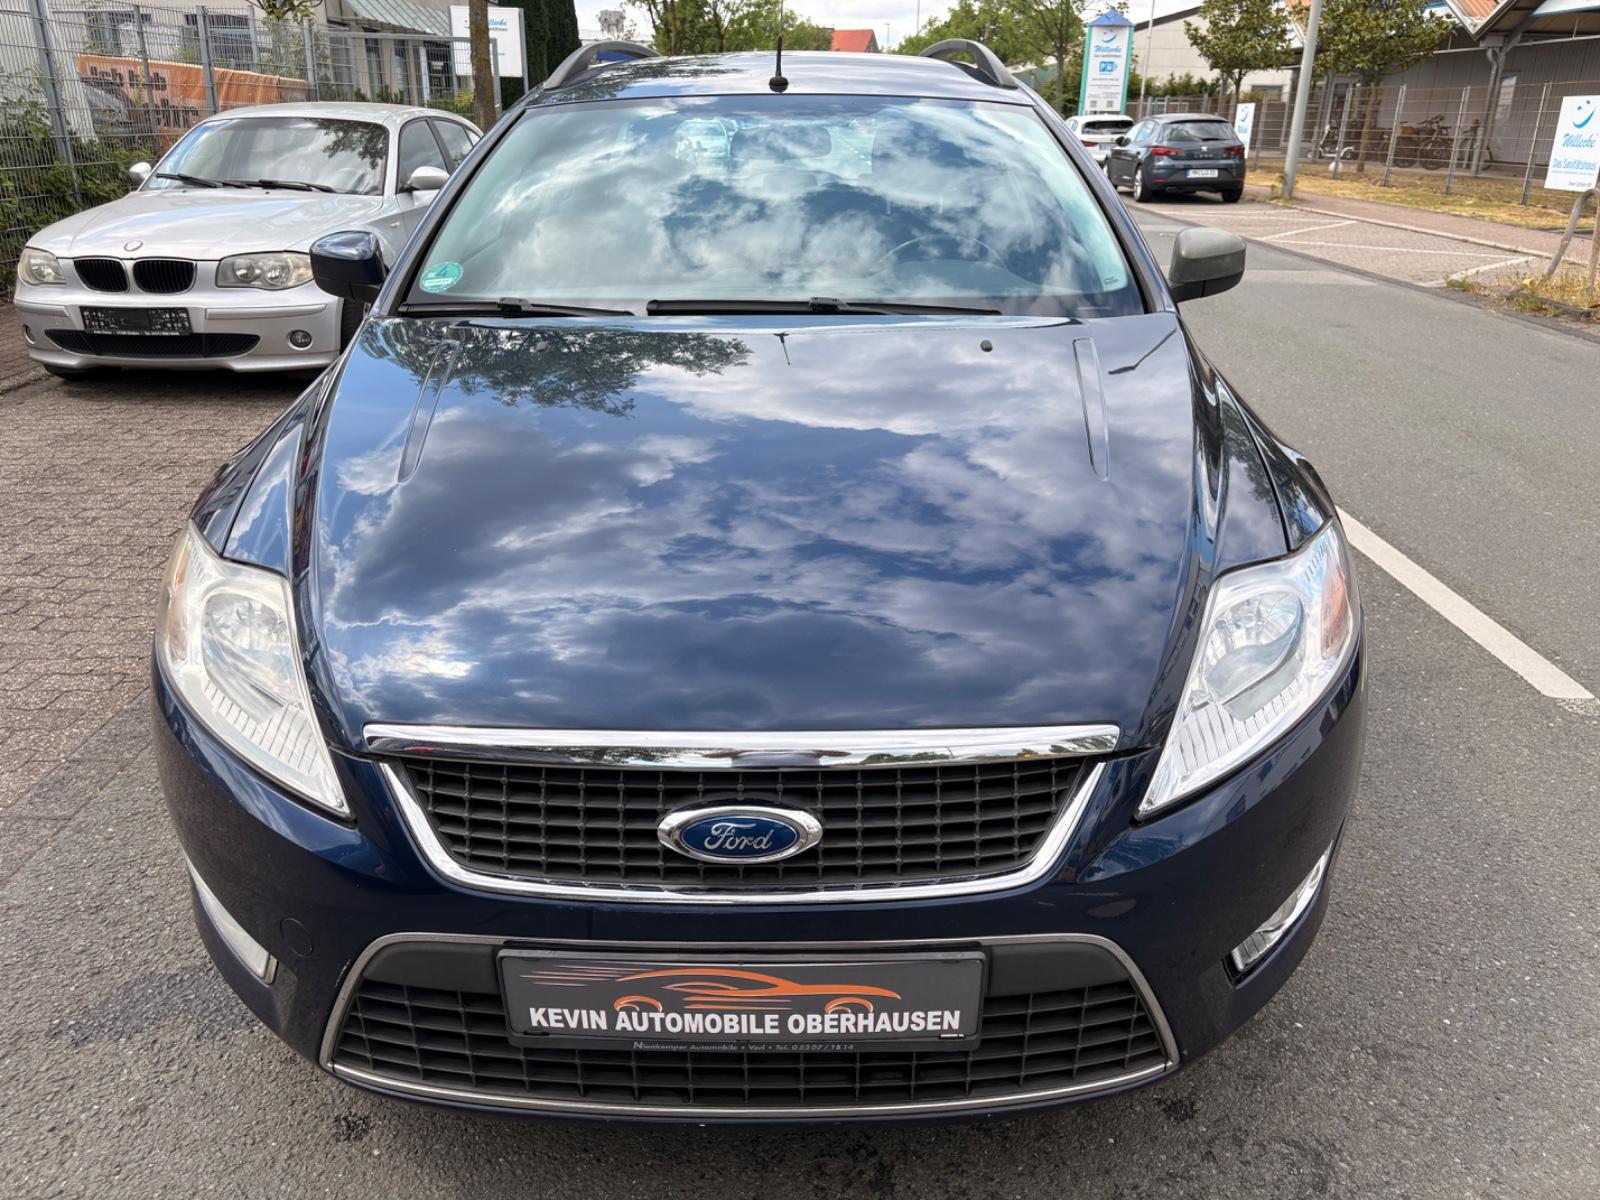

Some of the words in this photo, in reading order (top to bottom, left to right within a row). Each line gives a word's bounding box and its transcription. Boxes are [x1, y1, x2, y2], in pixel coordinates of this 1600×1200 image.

[704, 821, 774, 850] Ford
[529, 1007, 608, 1031] KEVIN
[615, 1011, 780, 1035] AUTOMOBILE
[787, 1010, 961, 1035] OBERHAUSEN
